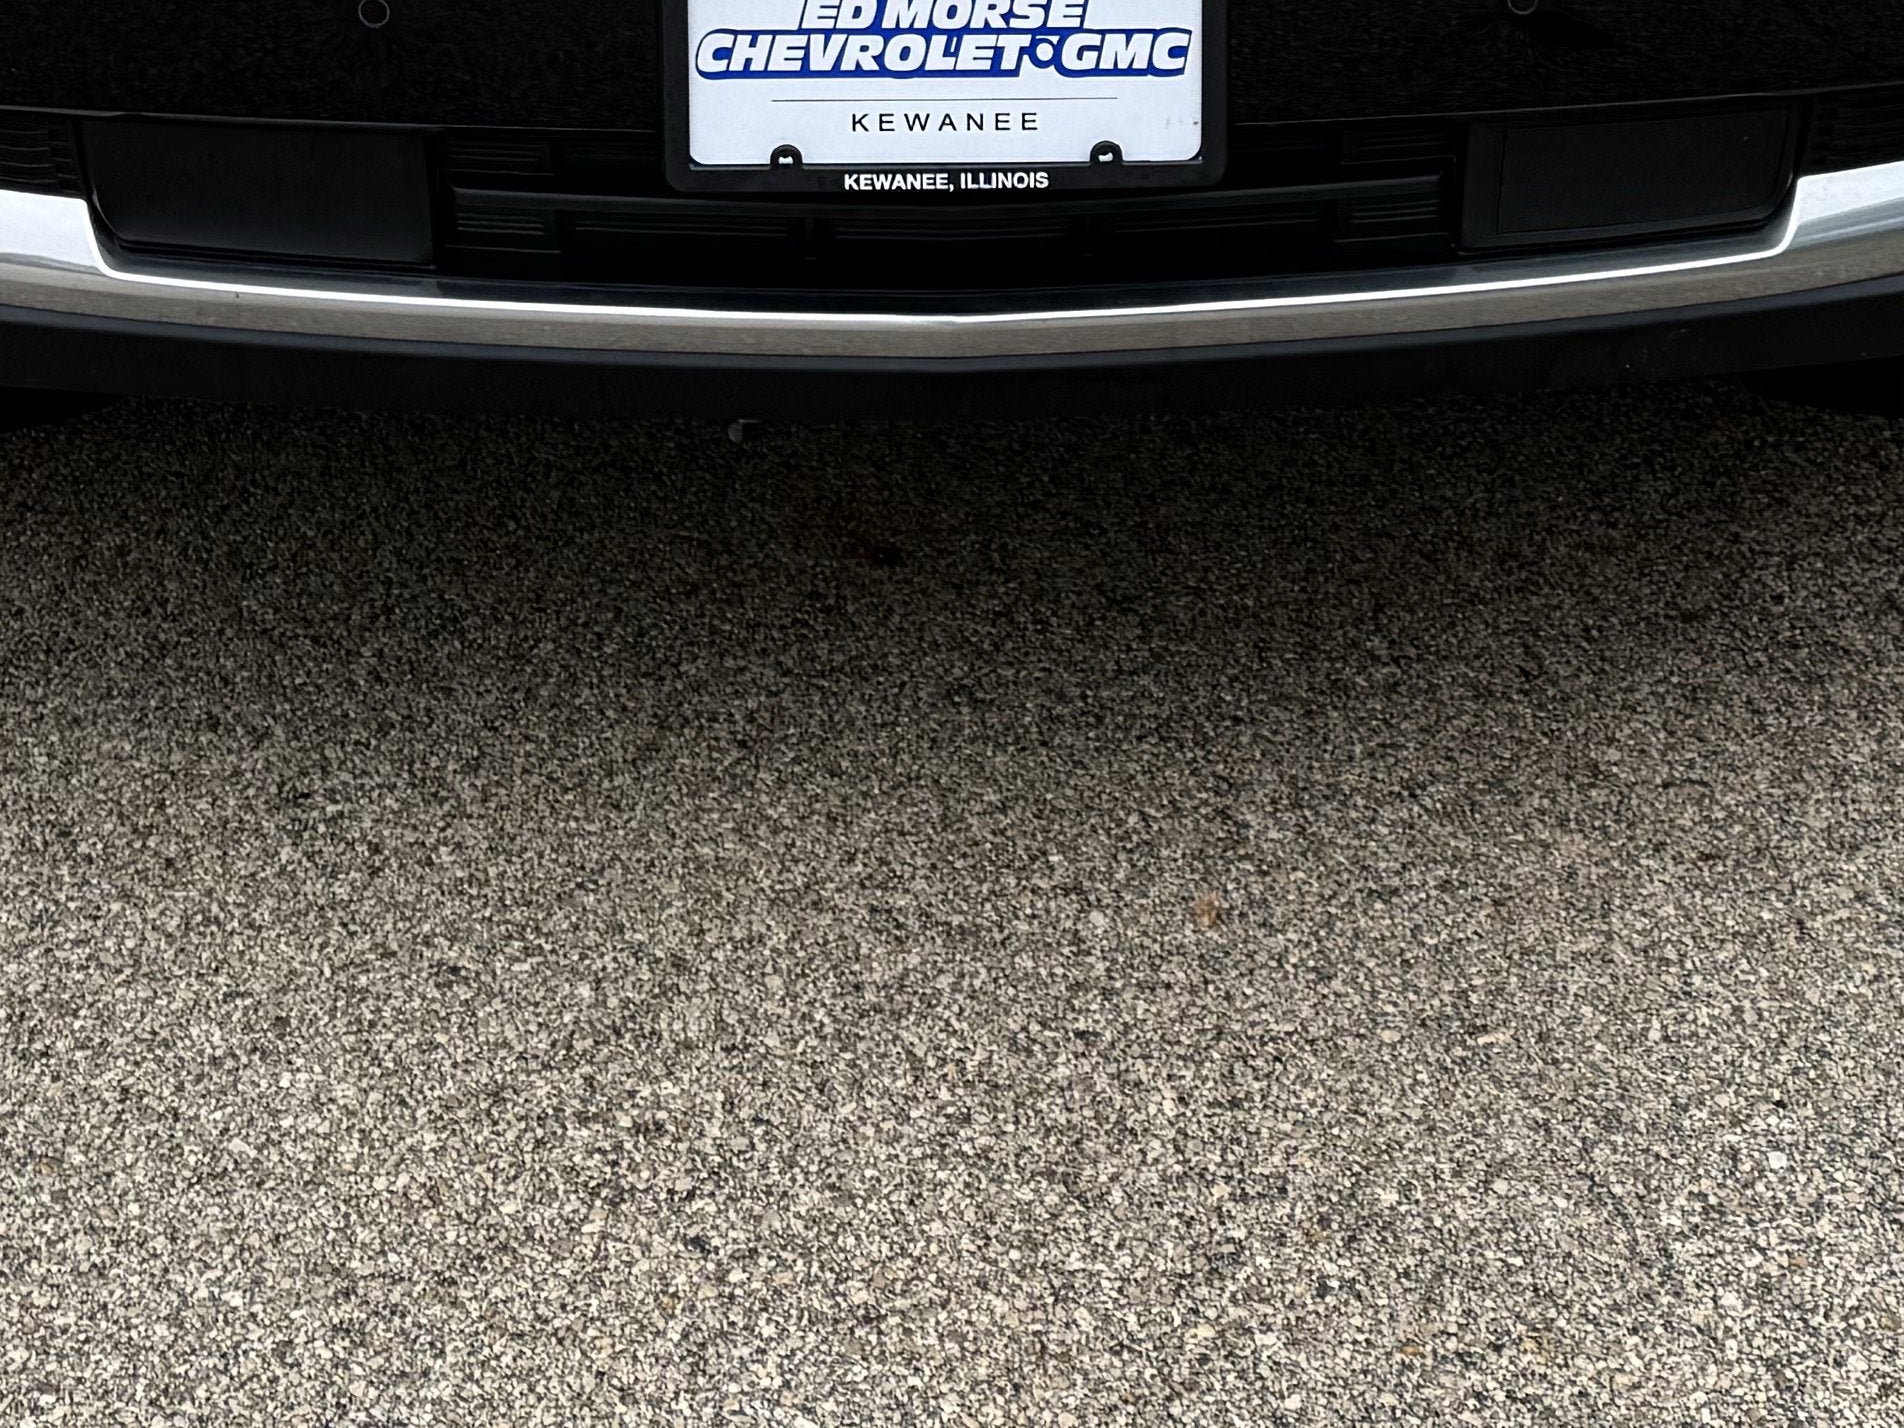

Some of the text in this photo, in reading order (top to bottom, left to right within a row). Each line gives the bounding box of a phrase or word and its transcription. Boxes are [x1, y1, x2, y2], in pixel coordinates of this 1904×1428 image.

[851, 112, 1038, 132] KEWANEE
[844, 171, 1050, 192] KEWANEE, ILLINOIS
